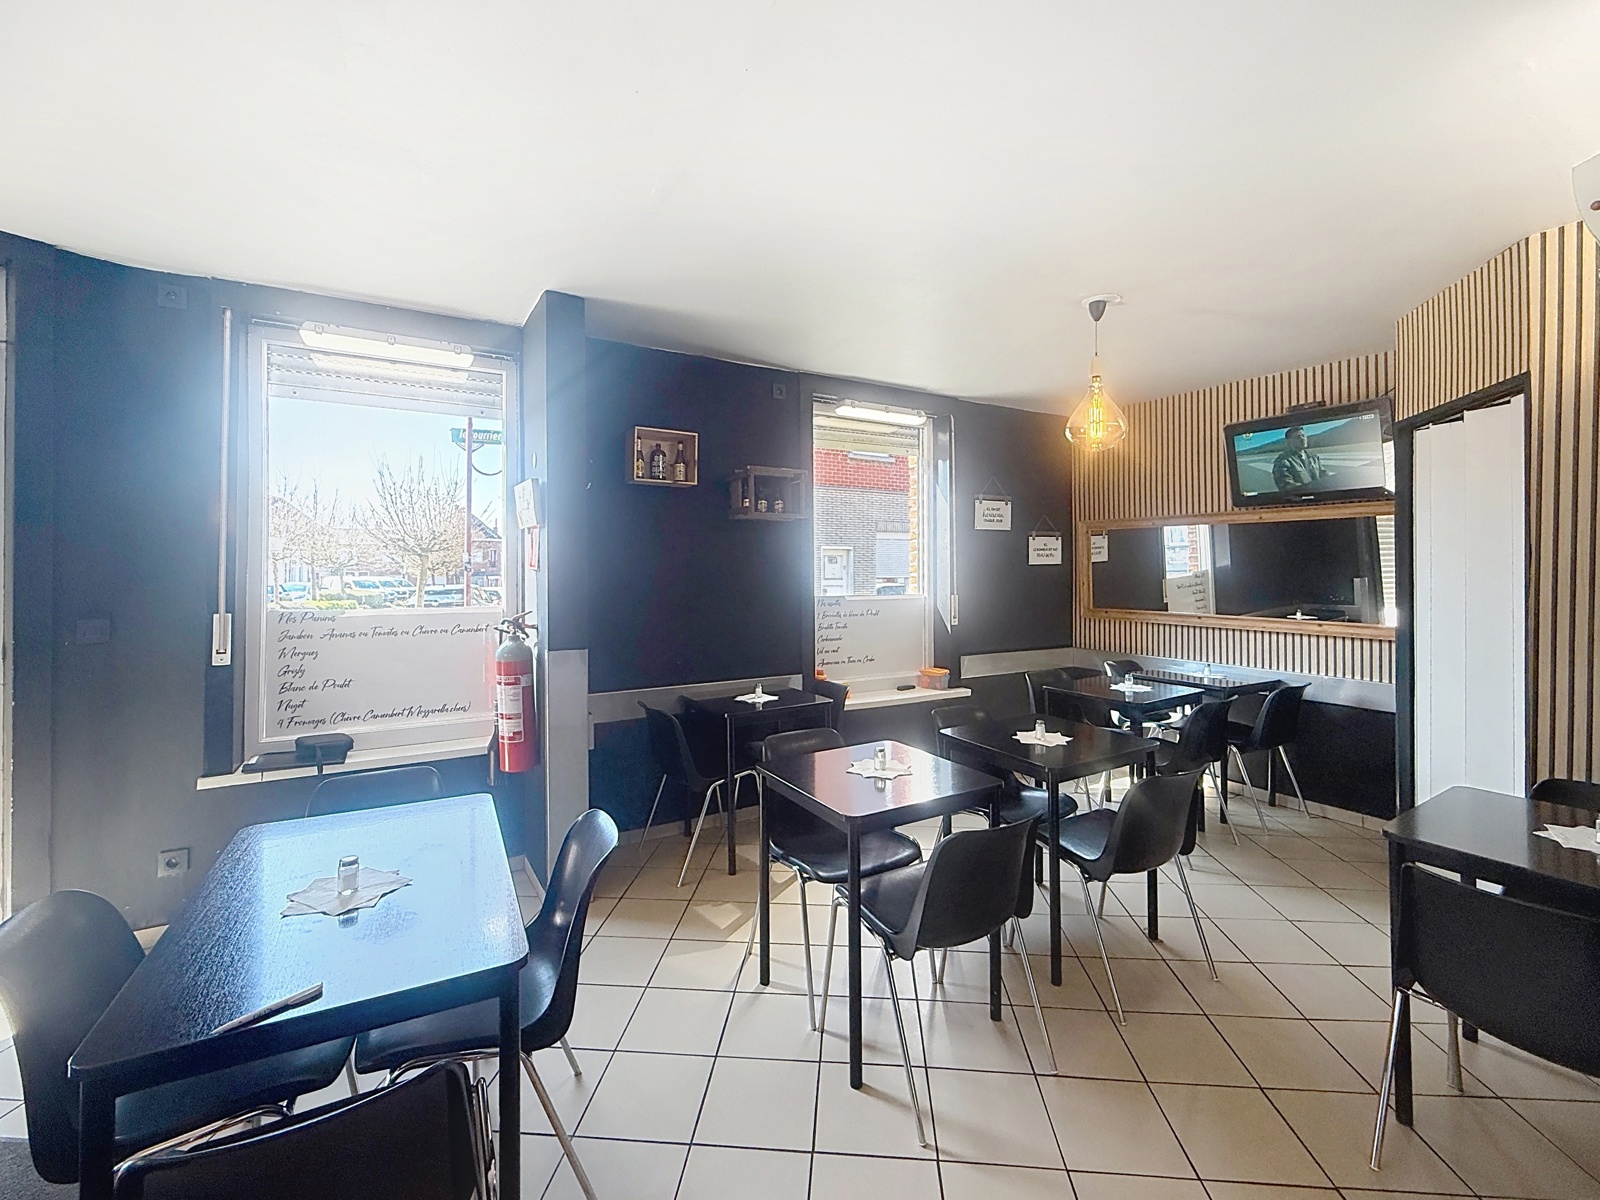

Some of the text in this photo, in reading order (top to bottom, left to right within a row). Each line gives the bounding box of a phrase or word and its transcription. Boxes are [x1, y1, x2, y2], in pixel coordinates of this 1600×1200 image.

[472, 431, 502, 440] ourrier
[278, 611, 336, 624] Nos Paninis
[278, 629, 314, 642] Jambon
[278, 646, 319, 661] Merguez
[277, 664, 306, 679] Grizly
[278, 678, 354, 695] Blanc de Poulet
[277, 698, 308, 714] Nuget
[277, 719, 284, 728] 4
[286, 715, 327, 729] Fromages
